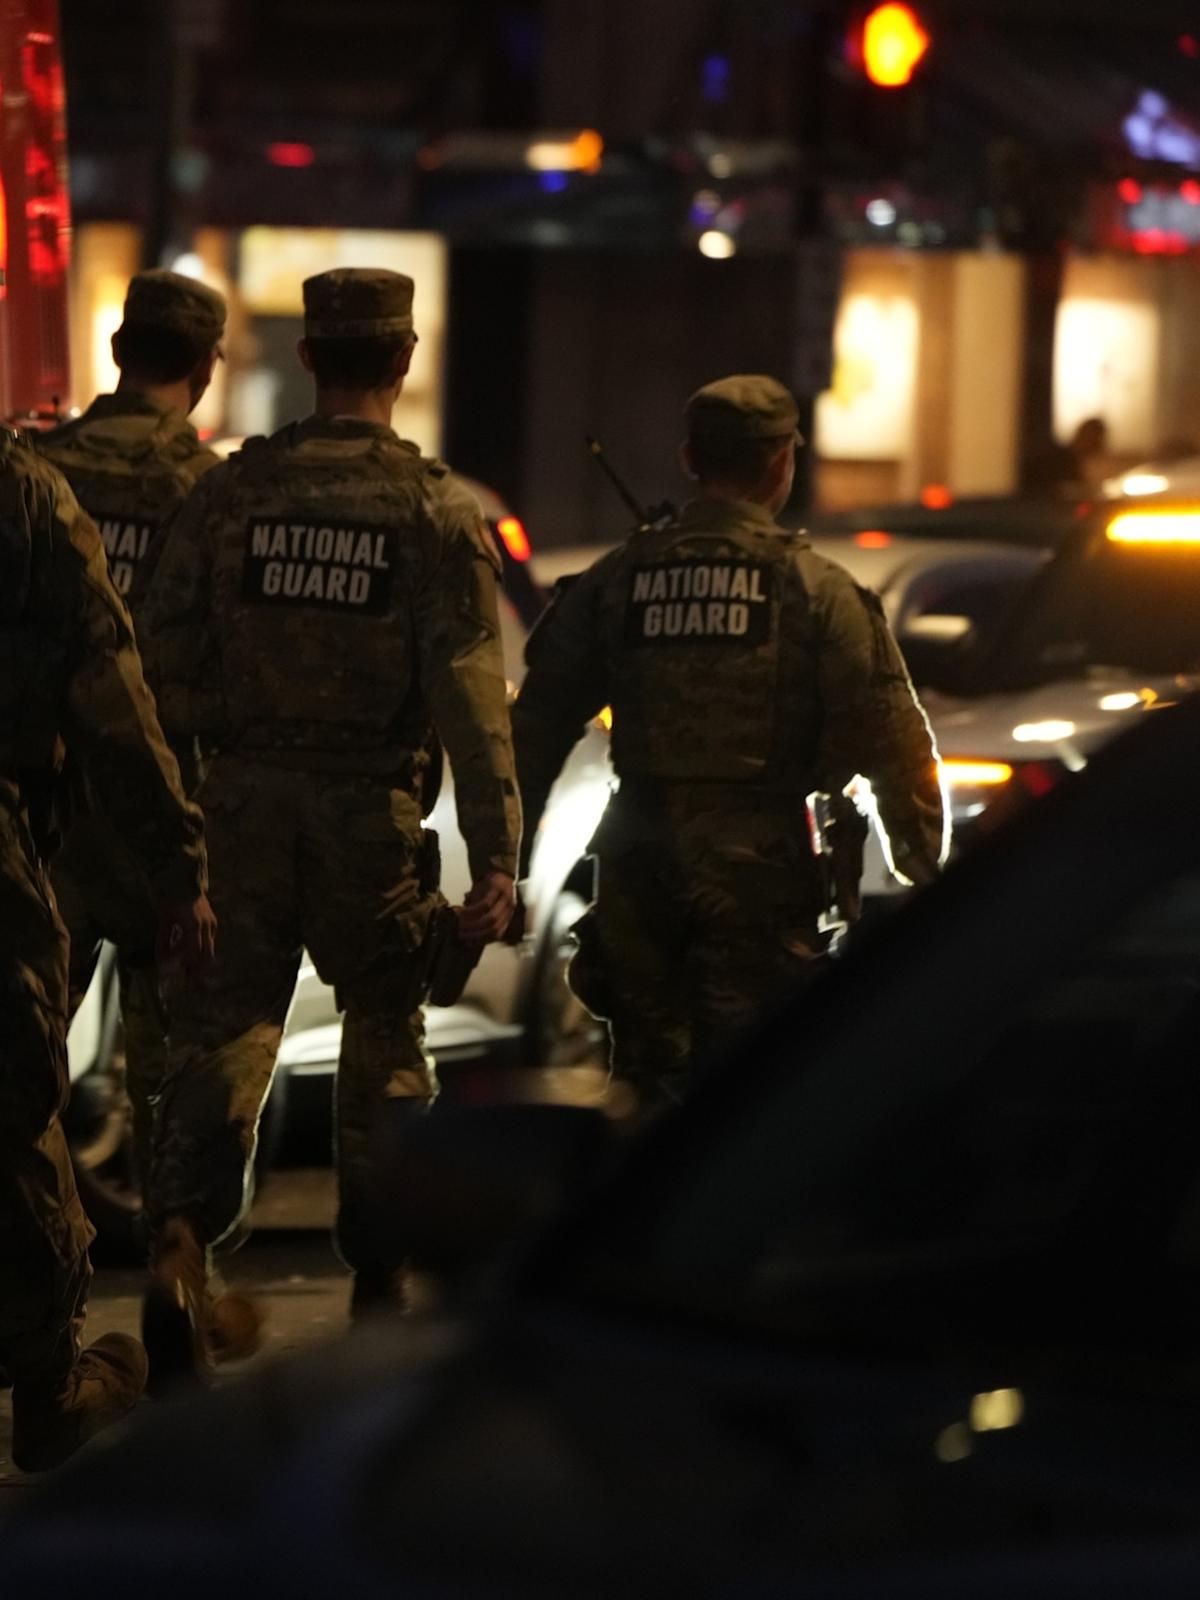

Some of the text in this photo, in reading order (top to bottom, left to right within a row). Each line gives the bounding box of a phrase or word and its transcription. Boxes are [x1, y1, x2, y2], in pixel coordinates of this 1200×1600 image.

[251, 524, 390, 569] NATIONAL
[262, 560, 371, 605] GUARD
[632, 565, 767, 603] NATIONAL
[643, 601, 749, 637] GUARD
